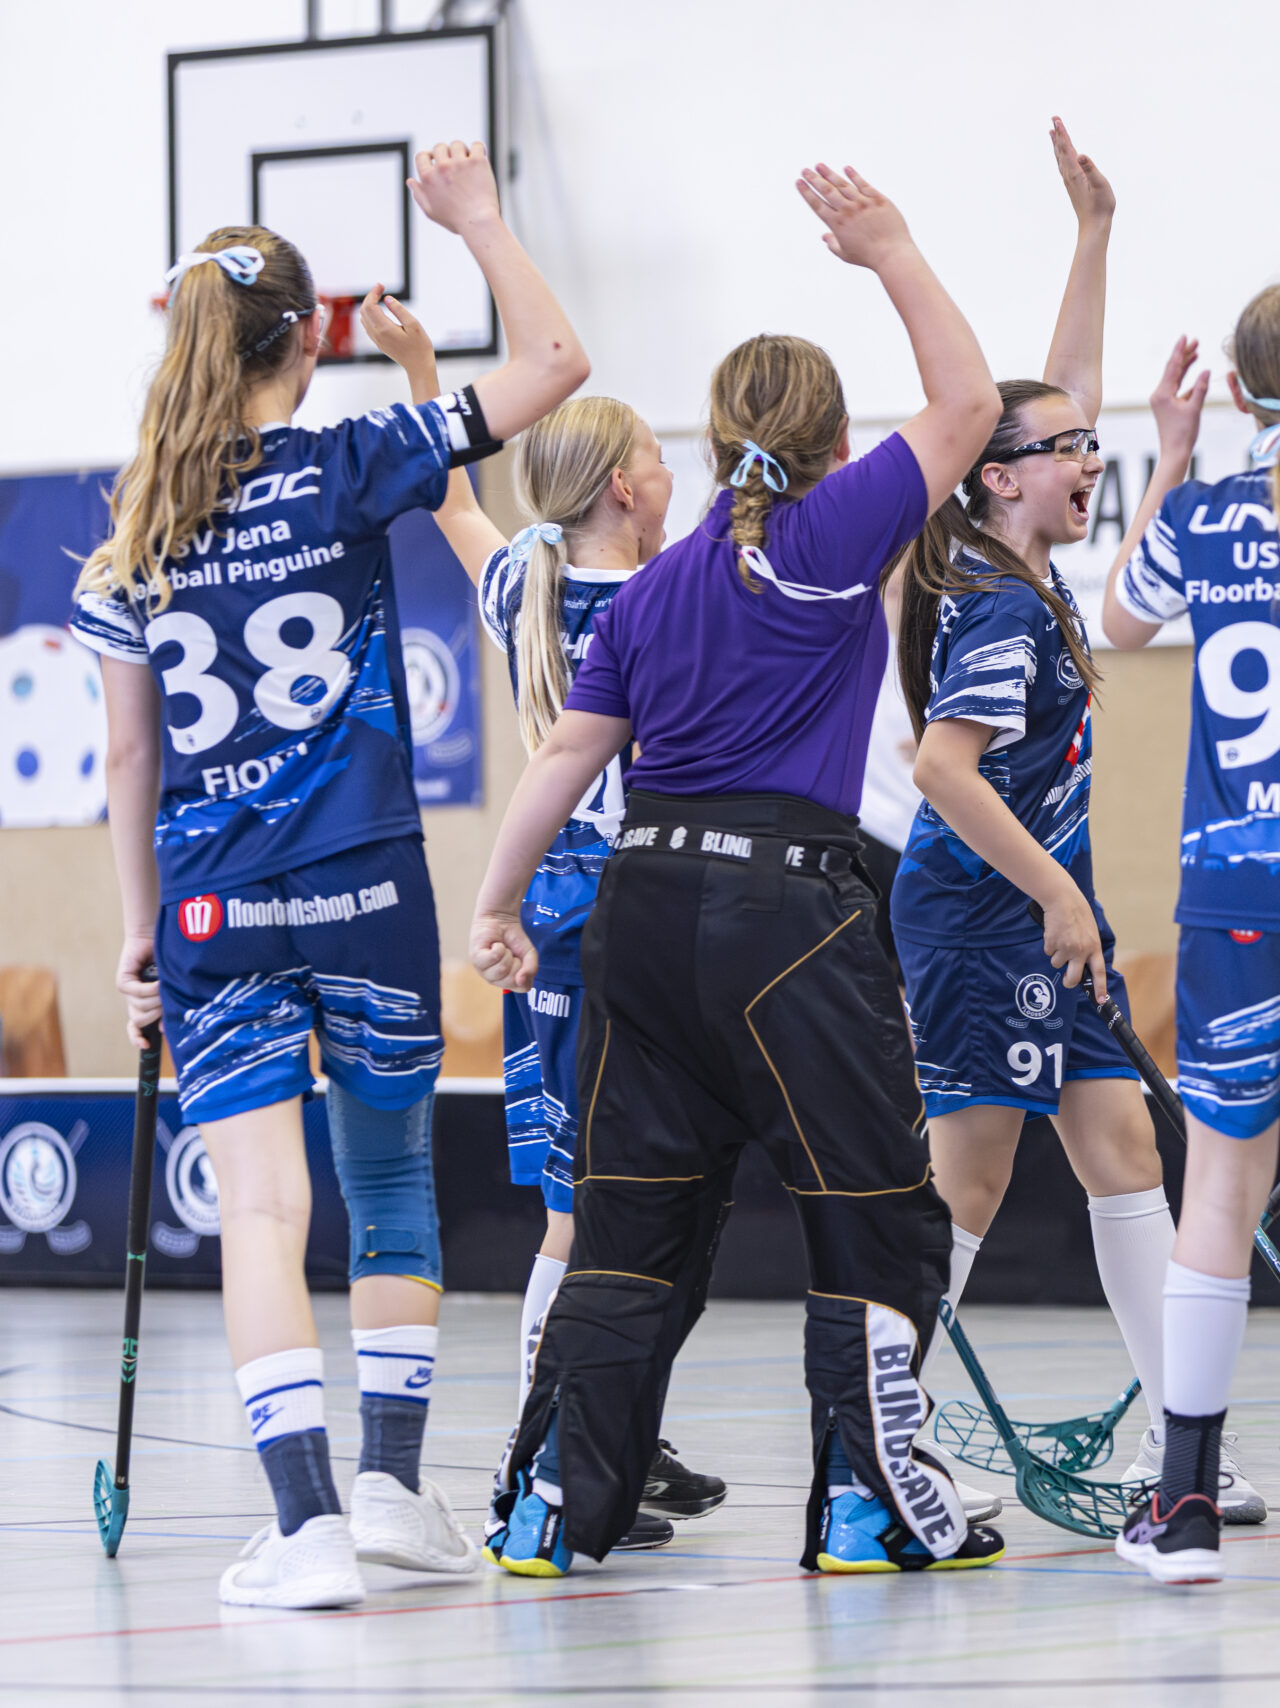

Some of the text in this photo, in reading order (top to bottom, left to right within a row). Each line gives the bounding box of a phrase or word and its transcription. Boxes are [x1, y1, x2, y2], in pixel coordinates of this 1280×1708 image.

[221, 520, 291, 554] Jena
[228, 541, 345, 582] Pinguine
[144, 591, 351, 755] 38
[1007, 1041, 1063, 1089] 91
